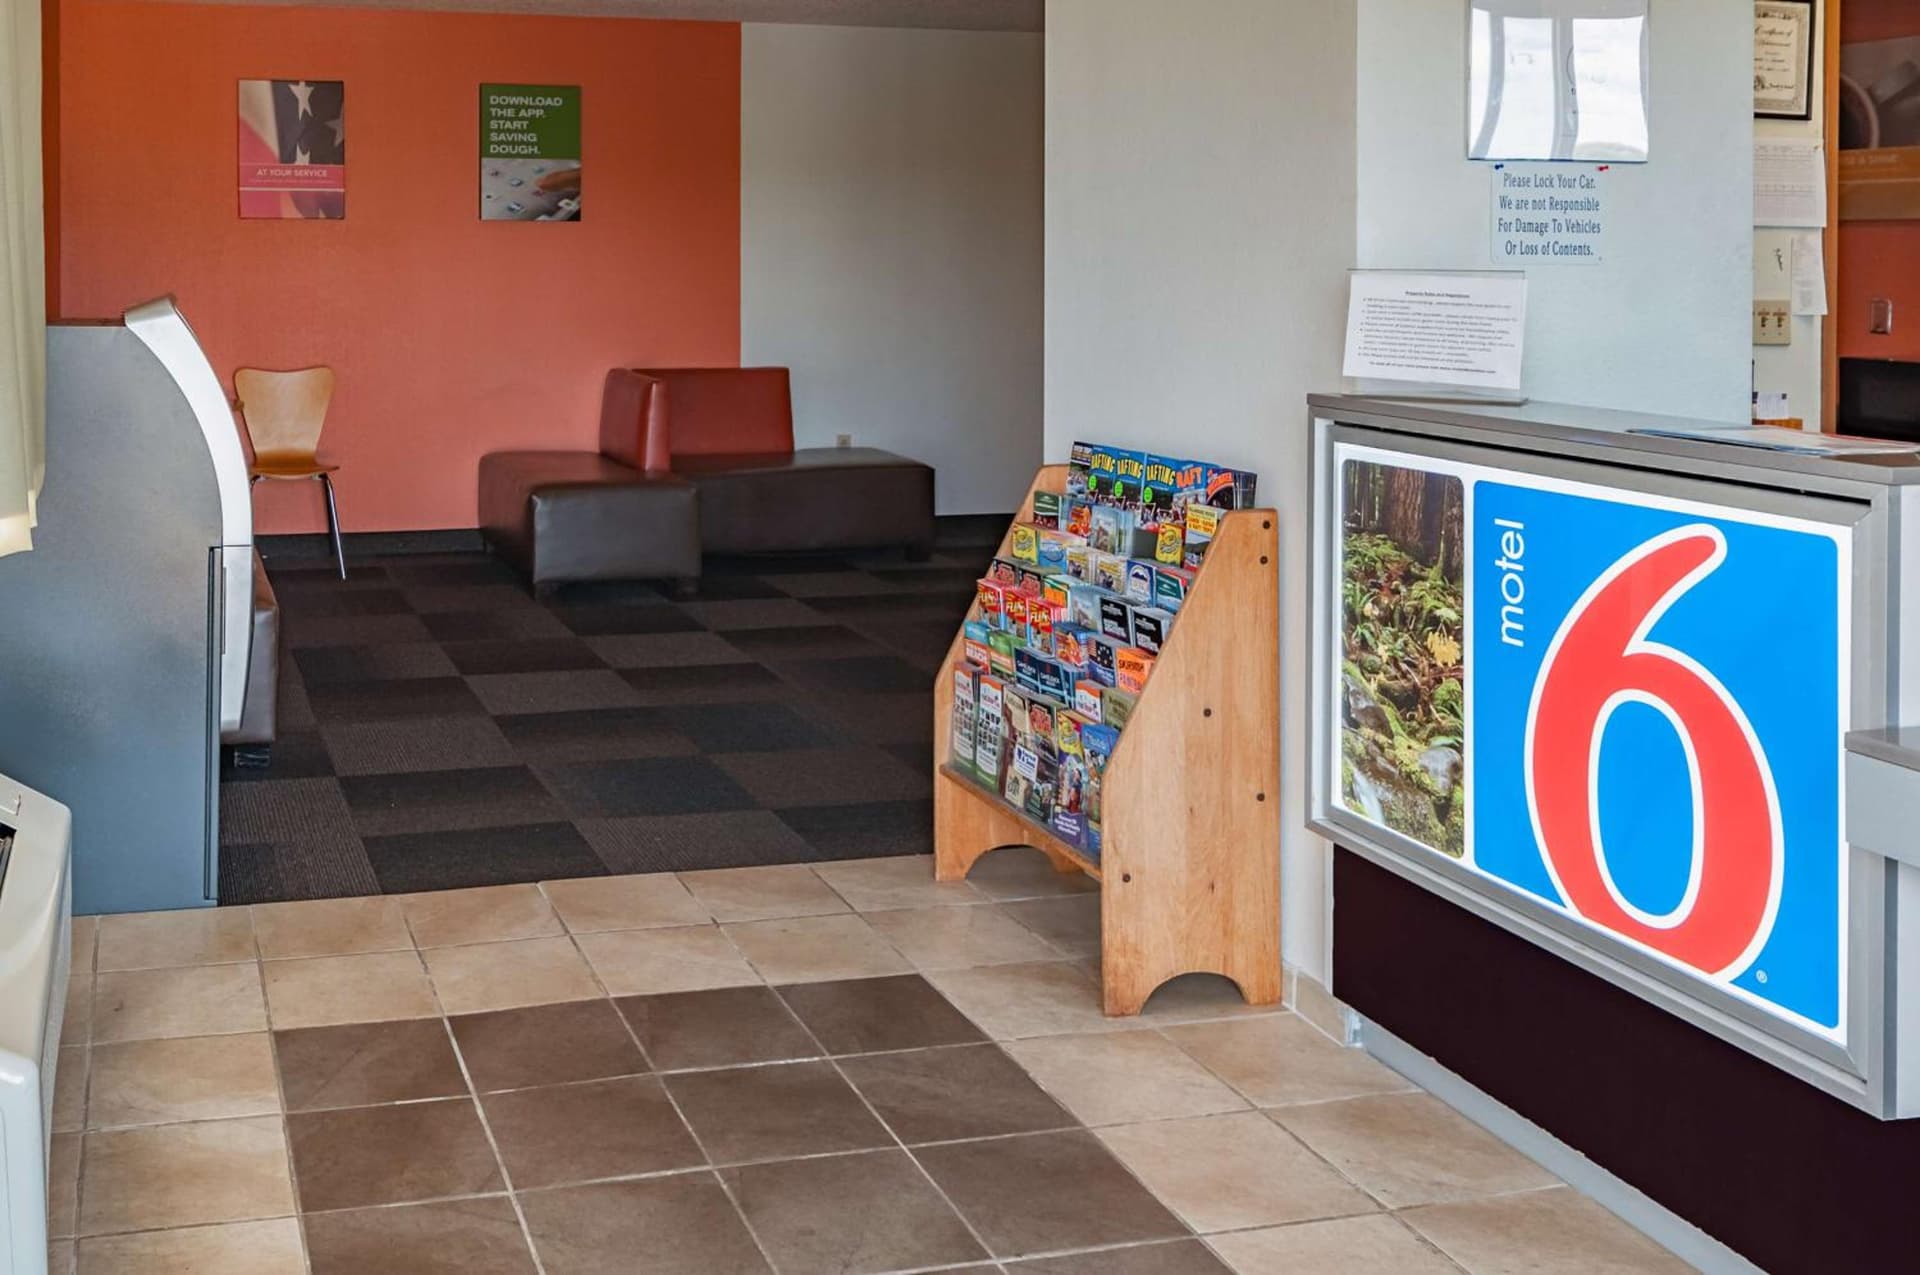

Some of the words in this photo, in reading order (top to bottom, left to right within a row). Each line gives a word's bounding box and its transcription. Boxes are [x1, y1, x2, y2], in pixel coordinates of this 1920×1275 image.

[489, 95, 563, 106] DOWNLOAD
[489, 107, 518, 117] THE
[489, 120, 529, 130] START
[489, 132, 537, 142] SAVING
[489, 144, 541, 154] DOUGH.
[256, 168, 267, 176] AT
[270, 168, 292, 177] YOUR
[294, 169, 328, 177] SERVICE
[1503, 172, 1531, 188] Please
[1534, 173, 1554, 188] Lock
[1557, 173, 1577, 189] Your
[1579, 174, 1596, 189] Car.
[1499, 195, 1512, 210] We
[1515, 199, 1529, 210] are
[1531, 198, 1546, 210] not
[1549, 196, 1600, 214] Responsible
[1498, 217, 1512, 232] For
[1515, 218, 1549, 236] Damage
[1552, 218, 1563, 233] To
[1565, 218, 1601, 234] Vehicles
[1505, 240, 1517, 256] Or
[1519, 240, 1538, 256] Loss
[1541, 241, 1550, 256] of
[1552, 241, 1594, 256] Contents.
[1494, 518, 1524, 648] motel
[1524, 523, 1785, 984] 6
